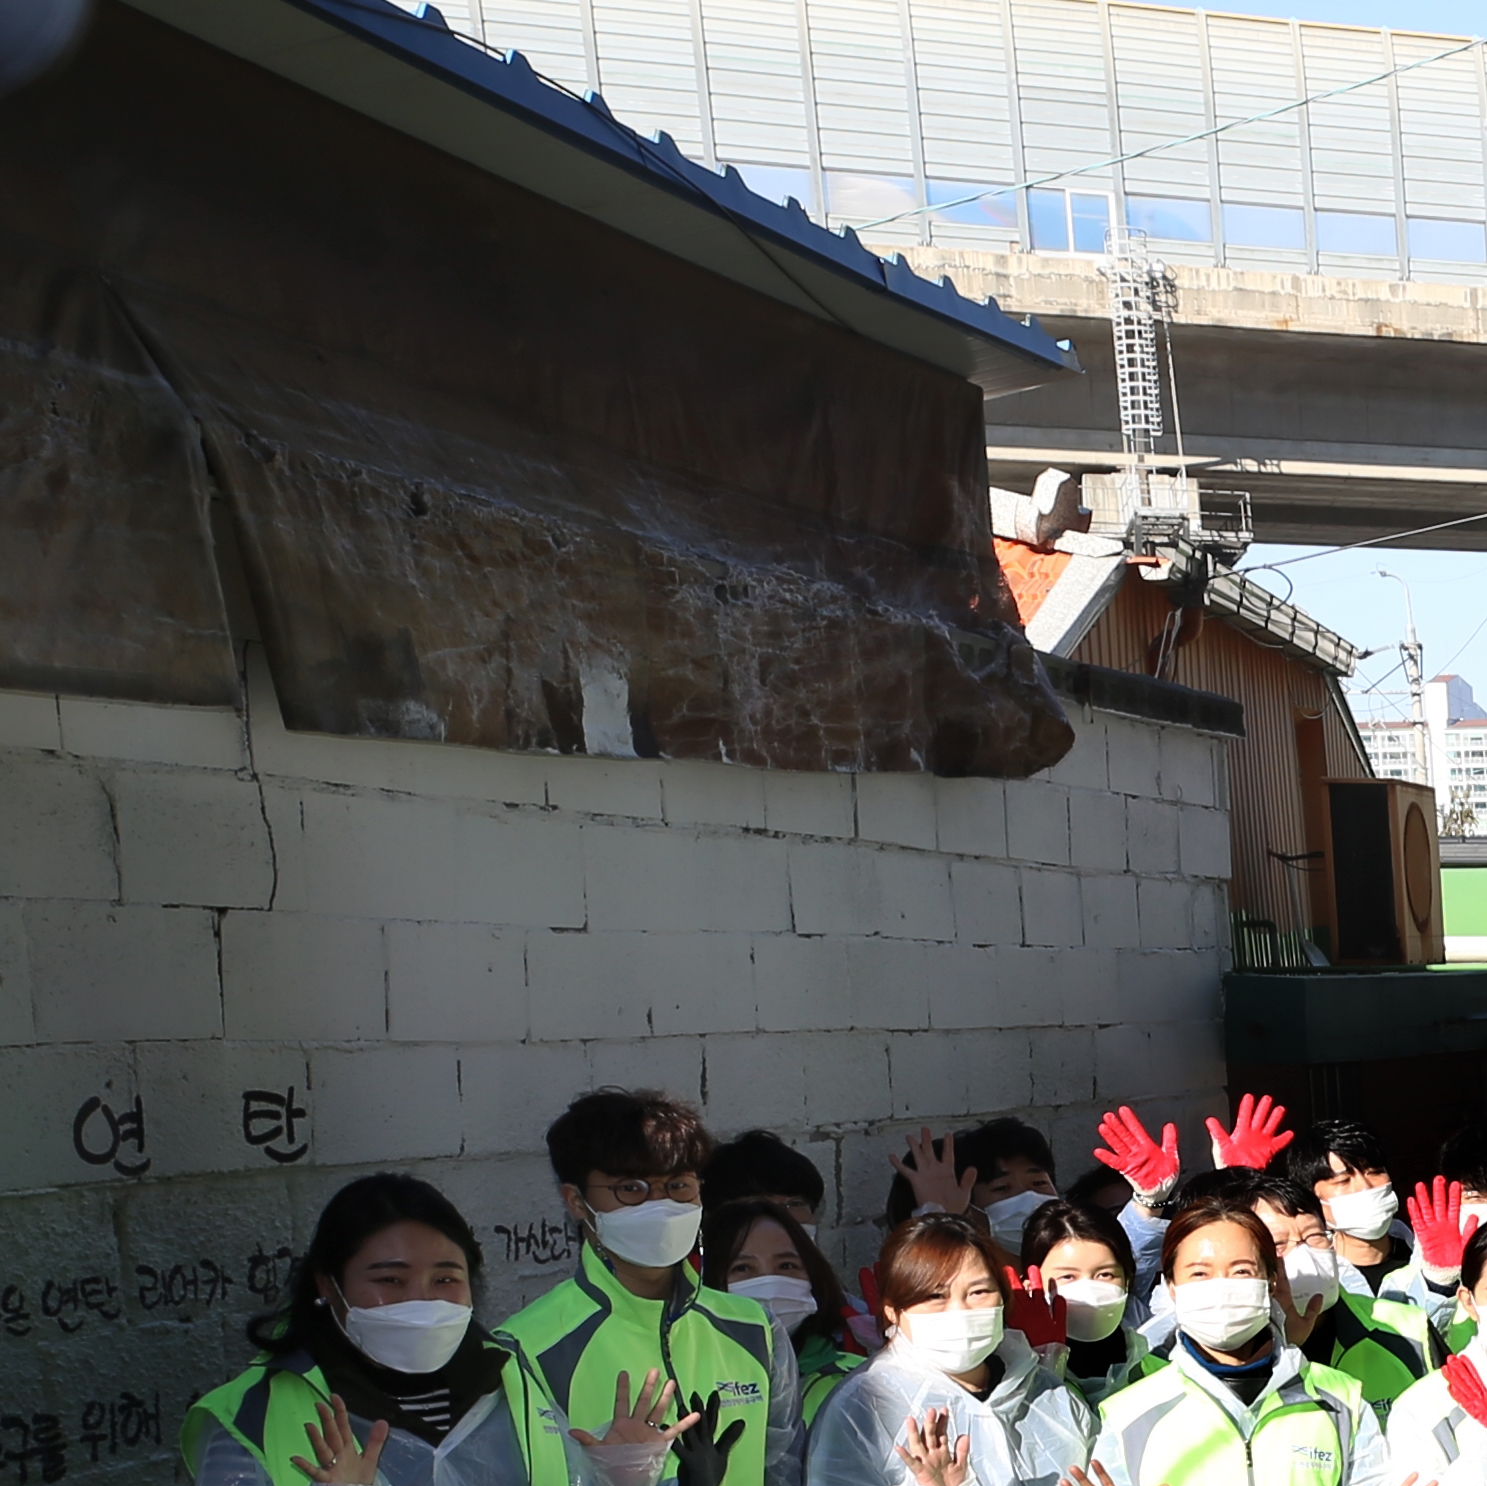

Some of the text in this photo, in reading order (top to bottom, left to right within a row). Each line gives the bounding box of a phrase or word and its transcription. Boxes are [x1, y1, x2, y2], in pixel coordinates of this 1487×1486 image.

[41, 1278, 121, 1333] 연탄
[0, 1391, 162, 1485] 구를 위해
